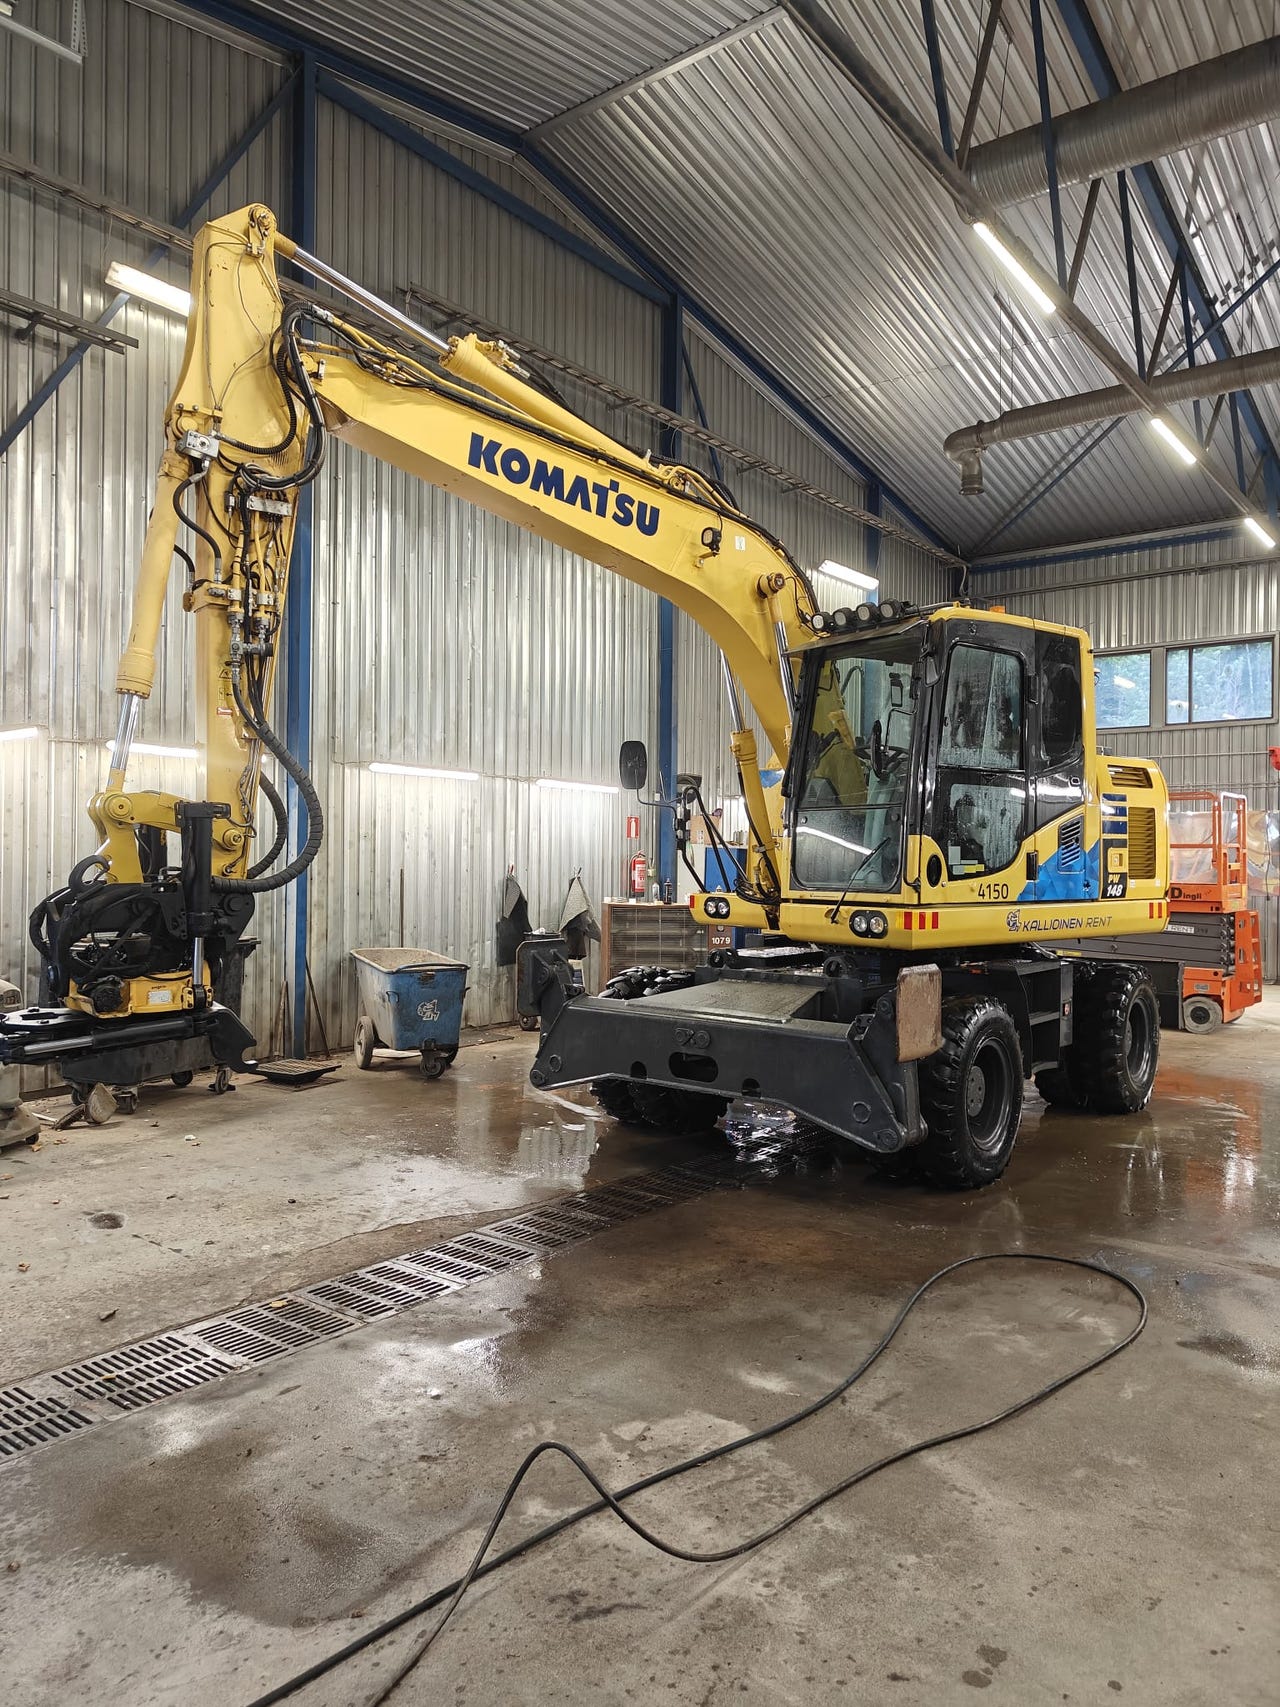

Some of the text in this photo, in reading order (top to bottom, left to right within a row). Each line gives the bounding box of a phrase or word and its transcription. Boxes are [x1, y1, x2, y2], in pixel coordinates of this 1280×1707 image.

[468, 432, 660, 537] KOMATSU
[1108, 874, 1120, 884] PW
[978, 883, 1009, 900] 4150
[1107, 884, 1123, 897] 148
[1170, 886, 1202, 901] Dingli
[1022, 916, 1112, 932] KALLIOINEN RENT
[711, 936, 731, 945] 1079
